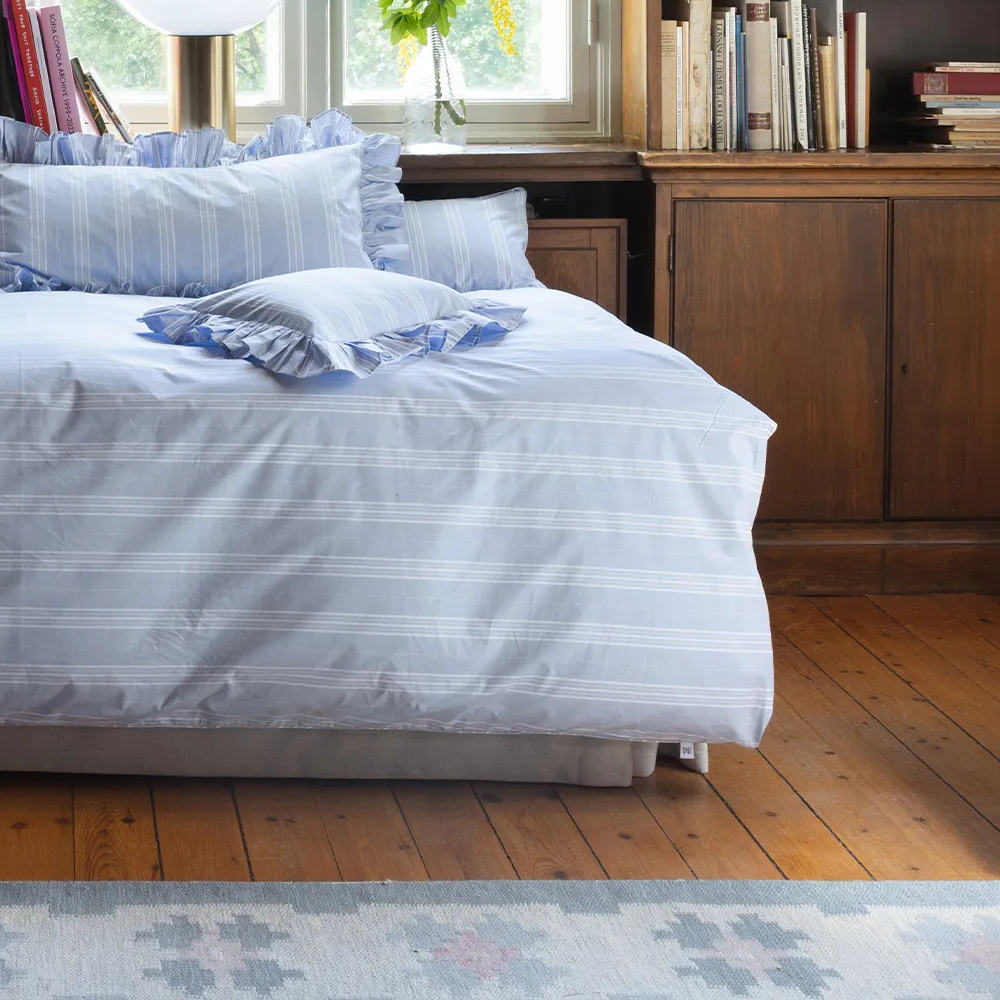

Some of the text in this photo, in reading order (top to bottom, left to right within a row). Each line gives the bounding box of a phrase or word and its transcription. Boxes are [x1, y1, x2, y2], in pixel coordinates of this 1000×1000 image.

[18, 13, 26, 28] YOUR
[48, 13, 58, 34] SOFIA
[21, 31, 29, 46] SHIT
[52, 34, 63, 67] COPPOLA
[715, 23, 724, 56] LOVSÅNG
[24, 48, 35, 77] TOGETHER
[57, 68, 68, 97] ARCHIVE
[32, 86, 44, 129] DAVID SHRIG
